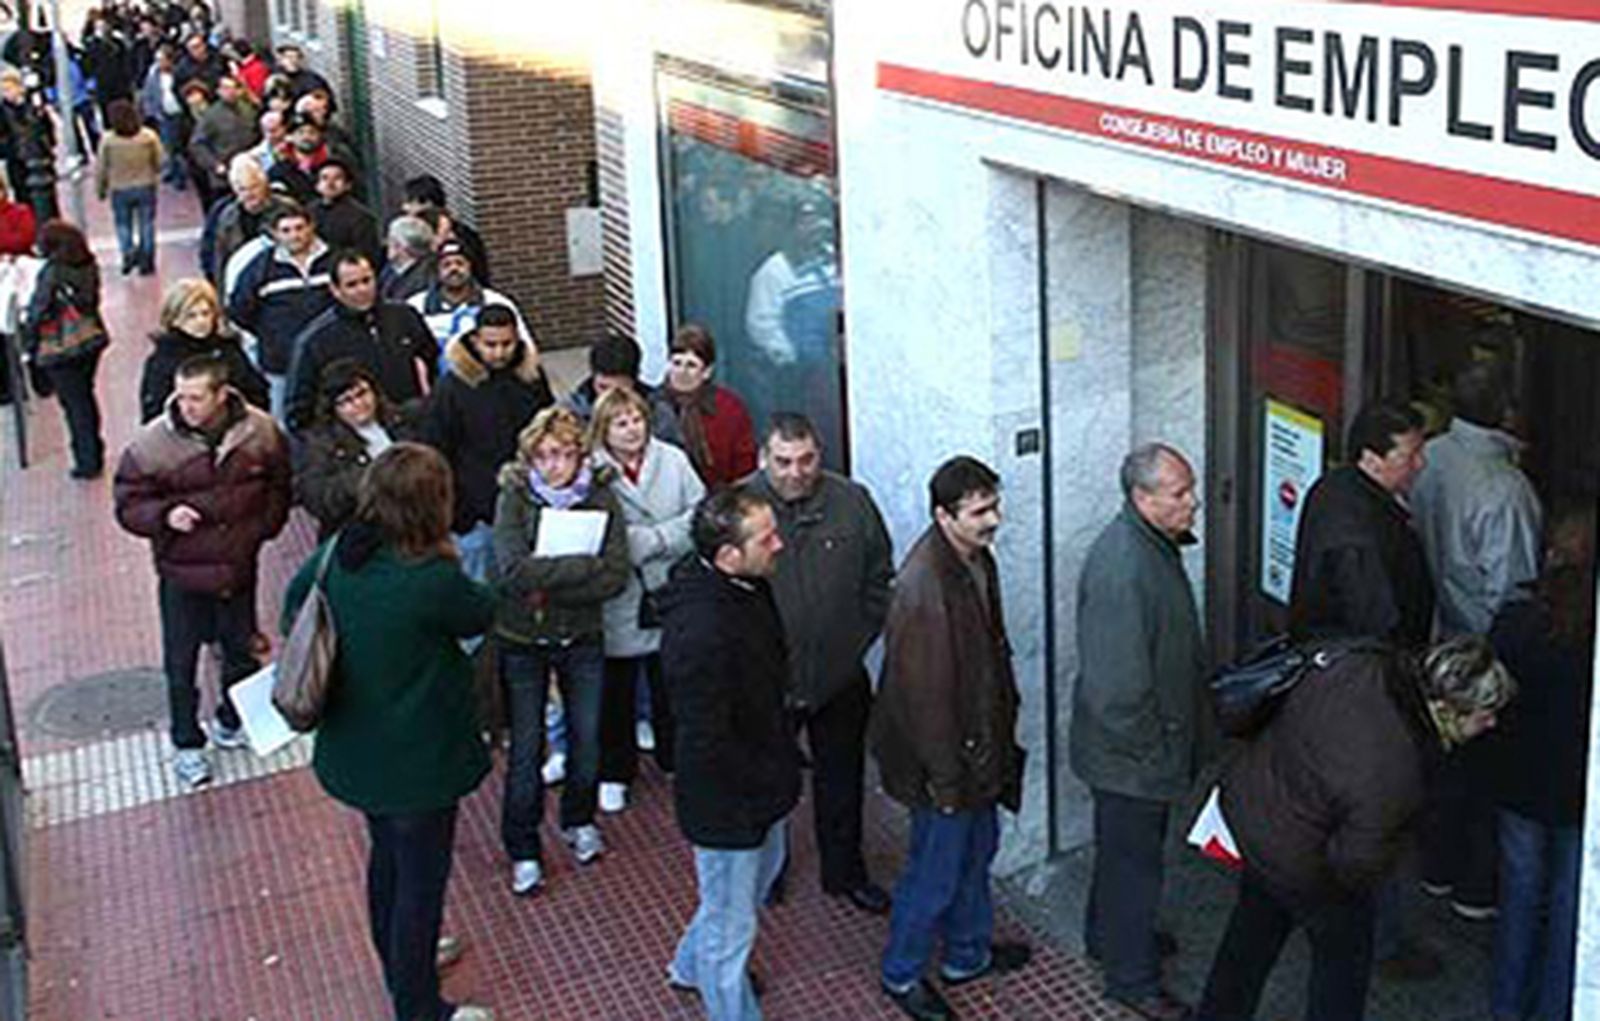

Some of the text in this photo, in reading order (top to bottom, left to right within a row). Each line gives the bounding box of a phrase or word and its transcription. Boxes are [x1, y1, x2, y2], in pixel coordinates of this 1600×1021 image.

[962, 0, 1154, 86] OFICINA
[1173, 16, 1253, 102] DE
[1183, 129, 1205, 151] DE
[1206, 132, 1270, 164] EMPLEO
[1271, 147, 1284, 168] Y
[1285, 149, 1347, 181] MUJER
